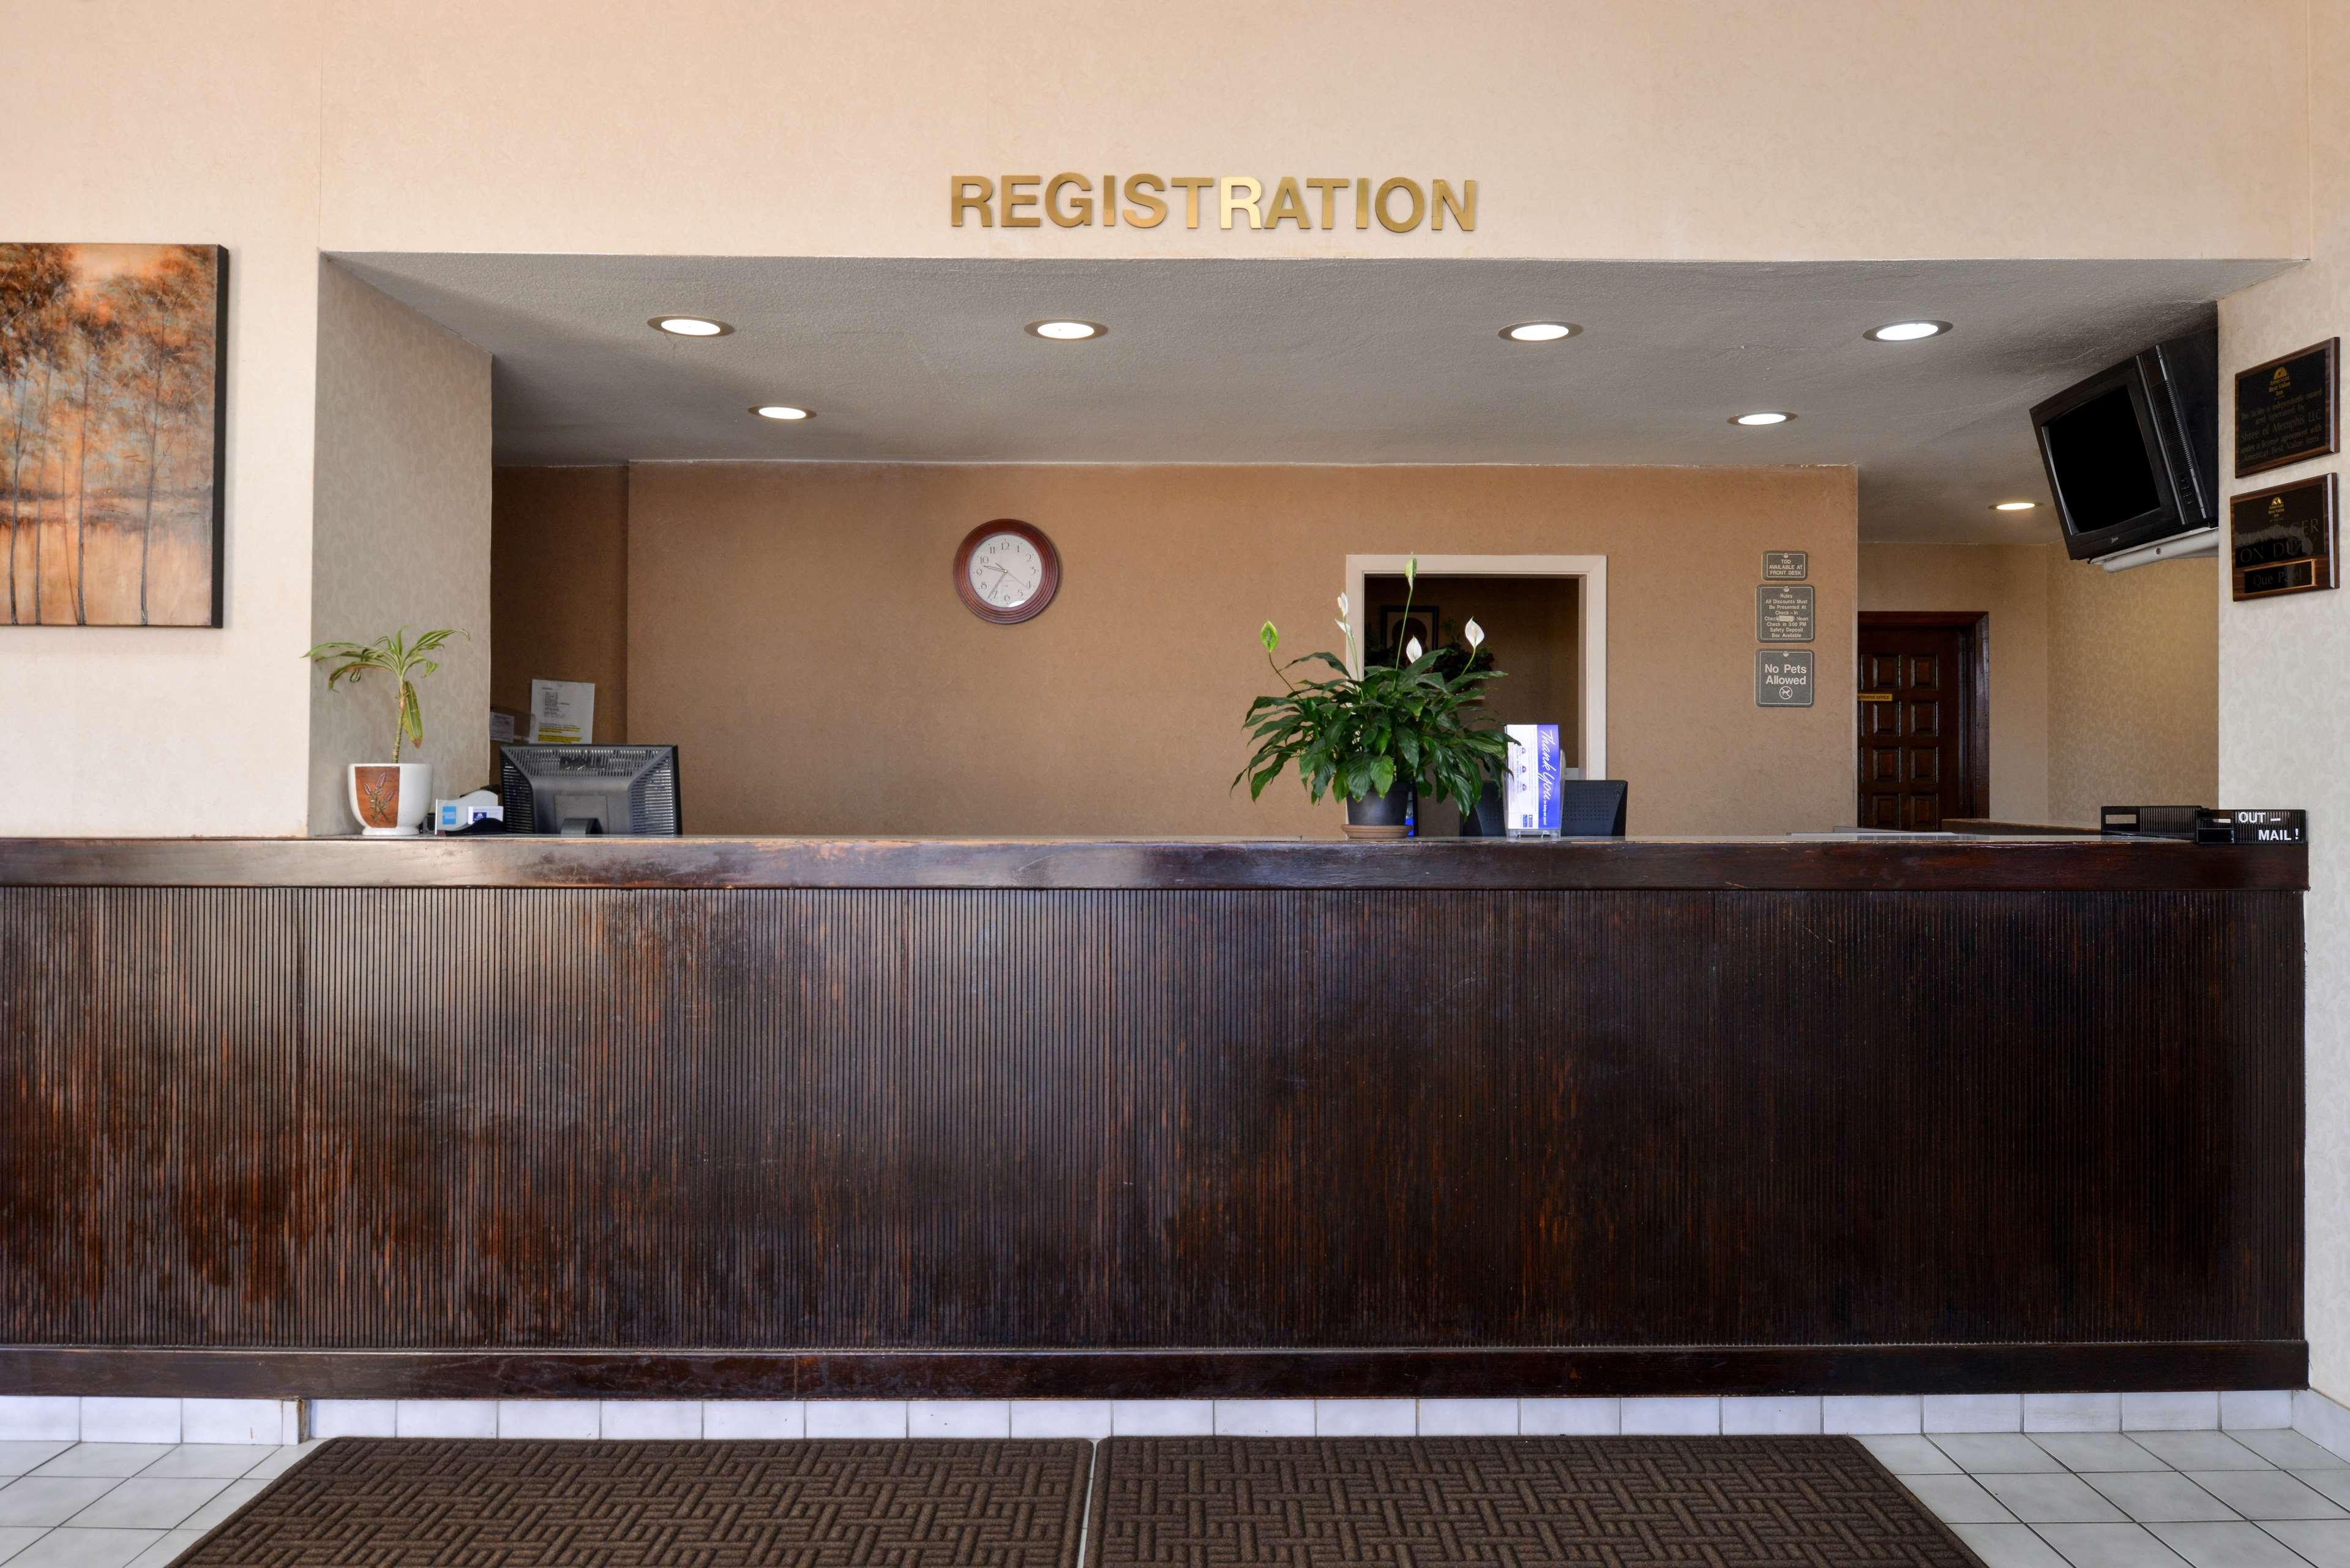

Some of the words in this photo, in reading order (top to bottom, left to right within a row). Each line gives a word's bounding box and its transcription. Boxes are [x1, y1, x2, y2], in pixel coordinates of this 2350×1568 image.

[951, 172, 1476, 233] REGISTRATION
[2272, 416, 2305, 432] Memphis
[2308, 409, 2322, 422] LLC
[1001, 542, 1009, 550] 12
[2273, 537, 2317, 558] DUY
[2253, 574, 2273, 588] Que
[1018, 589, 1023, 598] 5
[1765, 664, 1779, 674] No
[1784, 664, 1806, 674] Pets
[1765, 676, 1806, 685] Allowed
[1539, 730, 1557, 771] Thank
[1538, 769, 1555, 801] You
[2238, 812, 2266, 823] OUT
